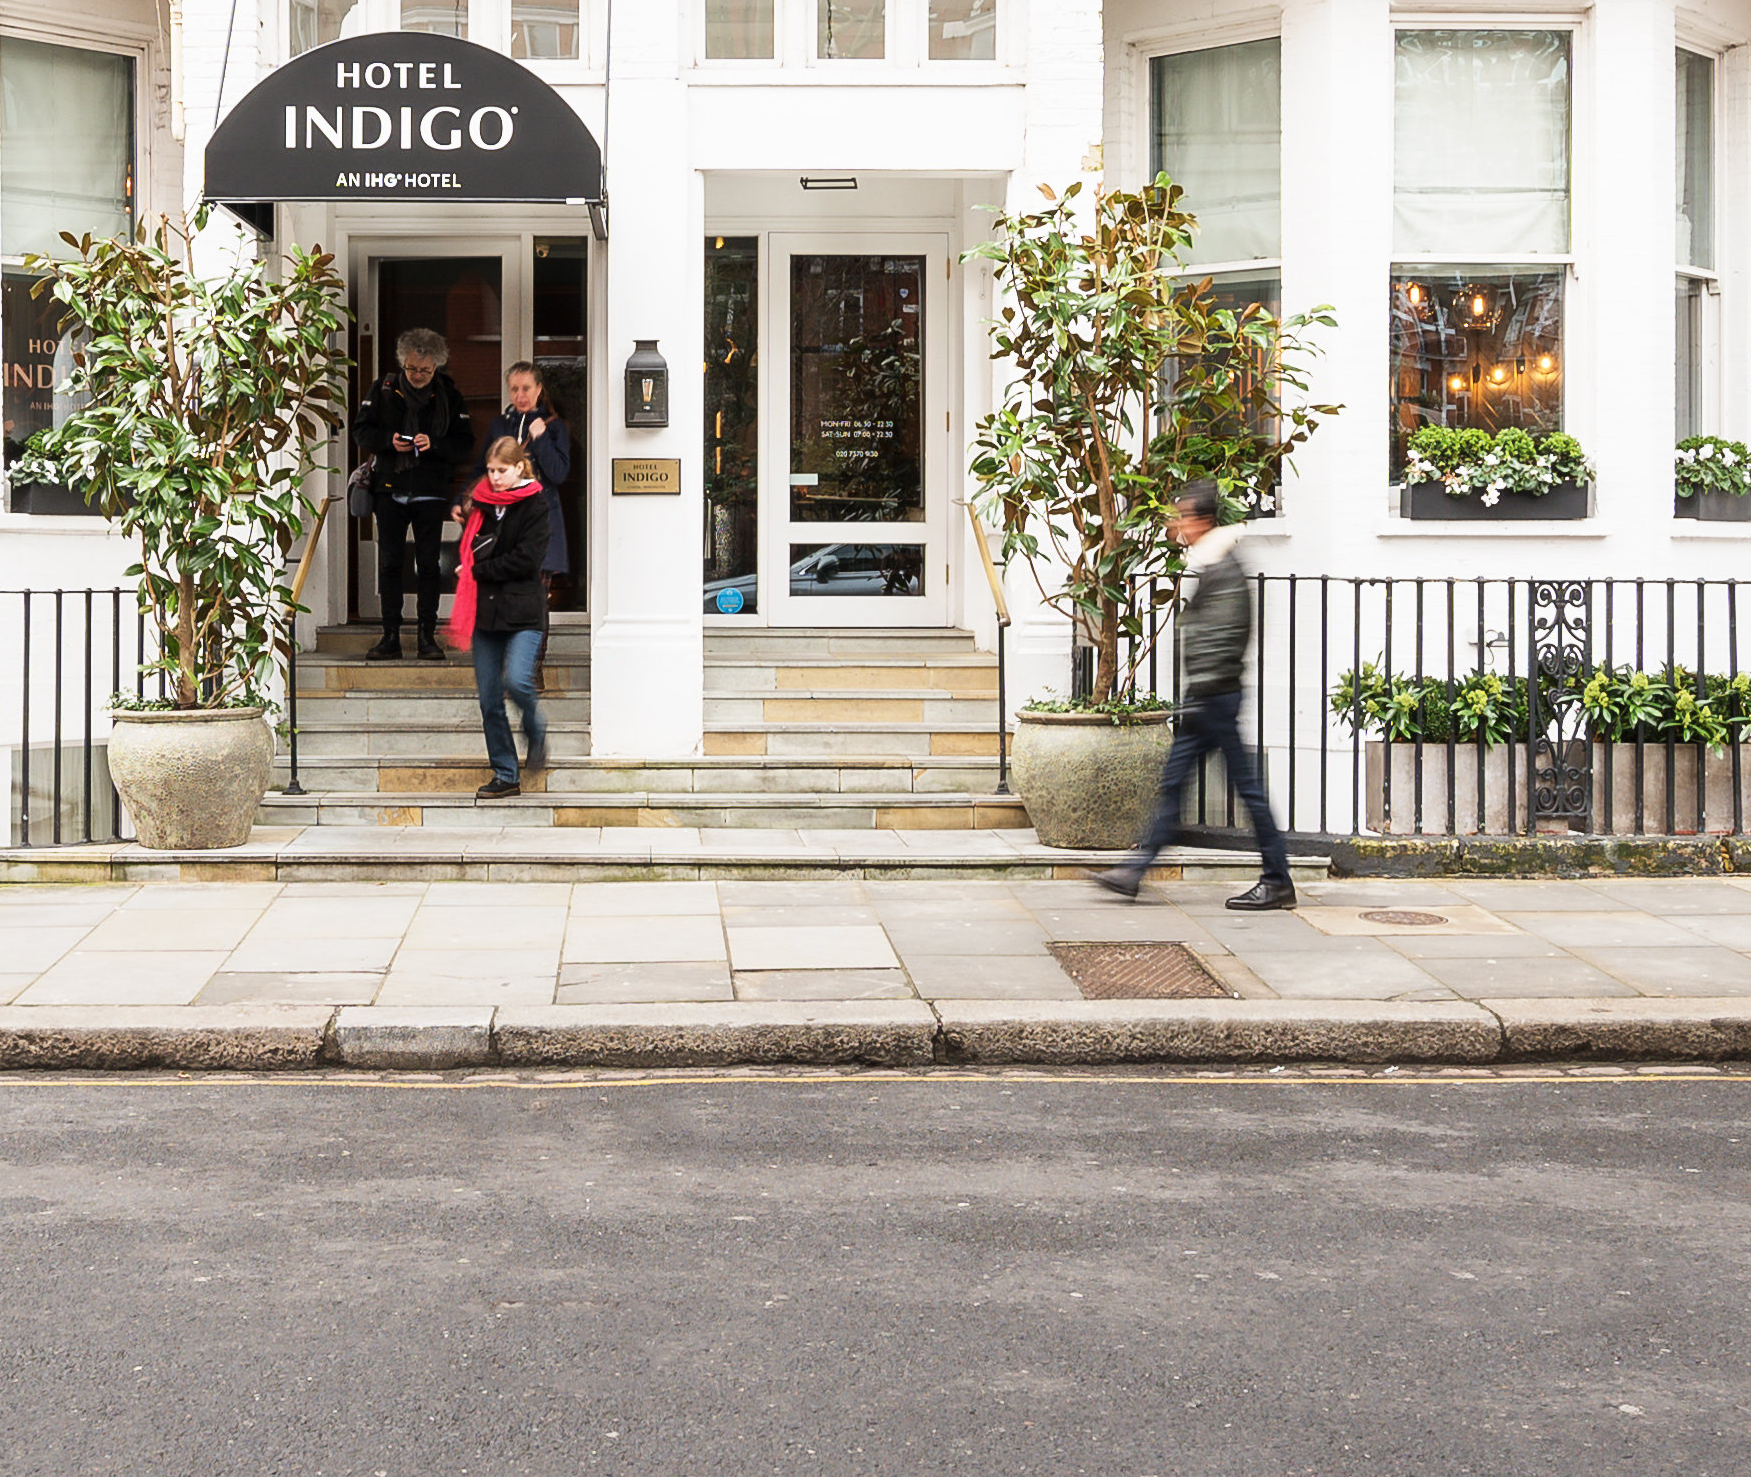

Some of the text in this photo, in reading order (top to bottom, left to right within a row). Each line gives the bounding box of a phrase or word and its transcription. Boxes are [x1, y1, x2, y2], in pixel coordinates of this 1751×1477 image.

[336, 62, 462, 88] HOTEL
[285, 105, 515, 150] INDIGO
[336, 173, 360, 188] AN
[404, 173, 462, 188] HOTEL
[623, 472, 669, 482] INDIGO
